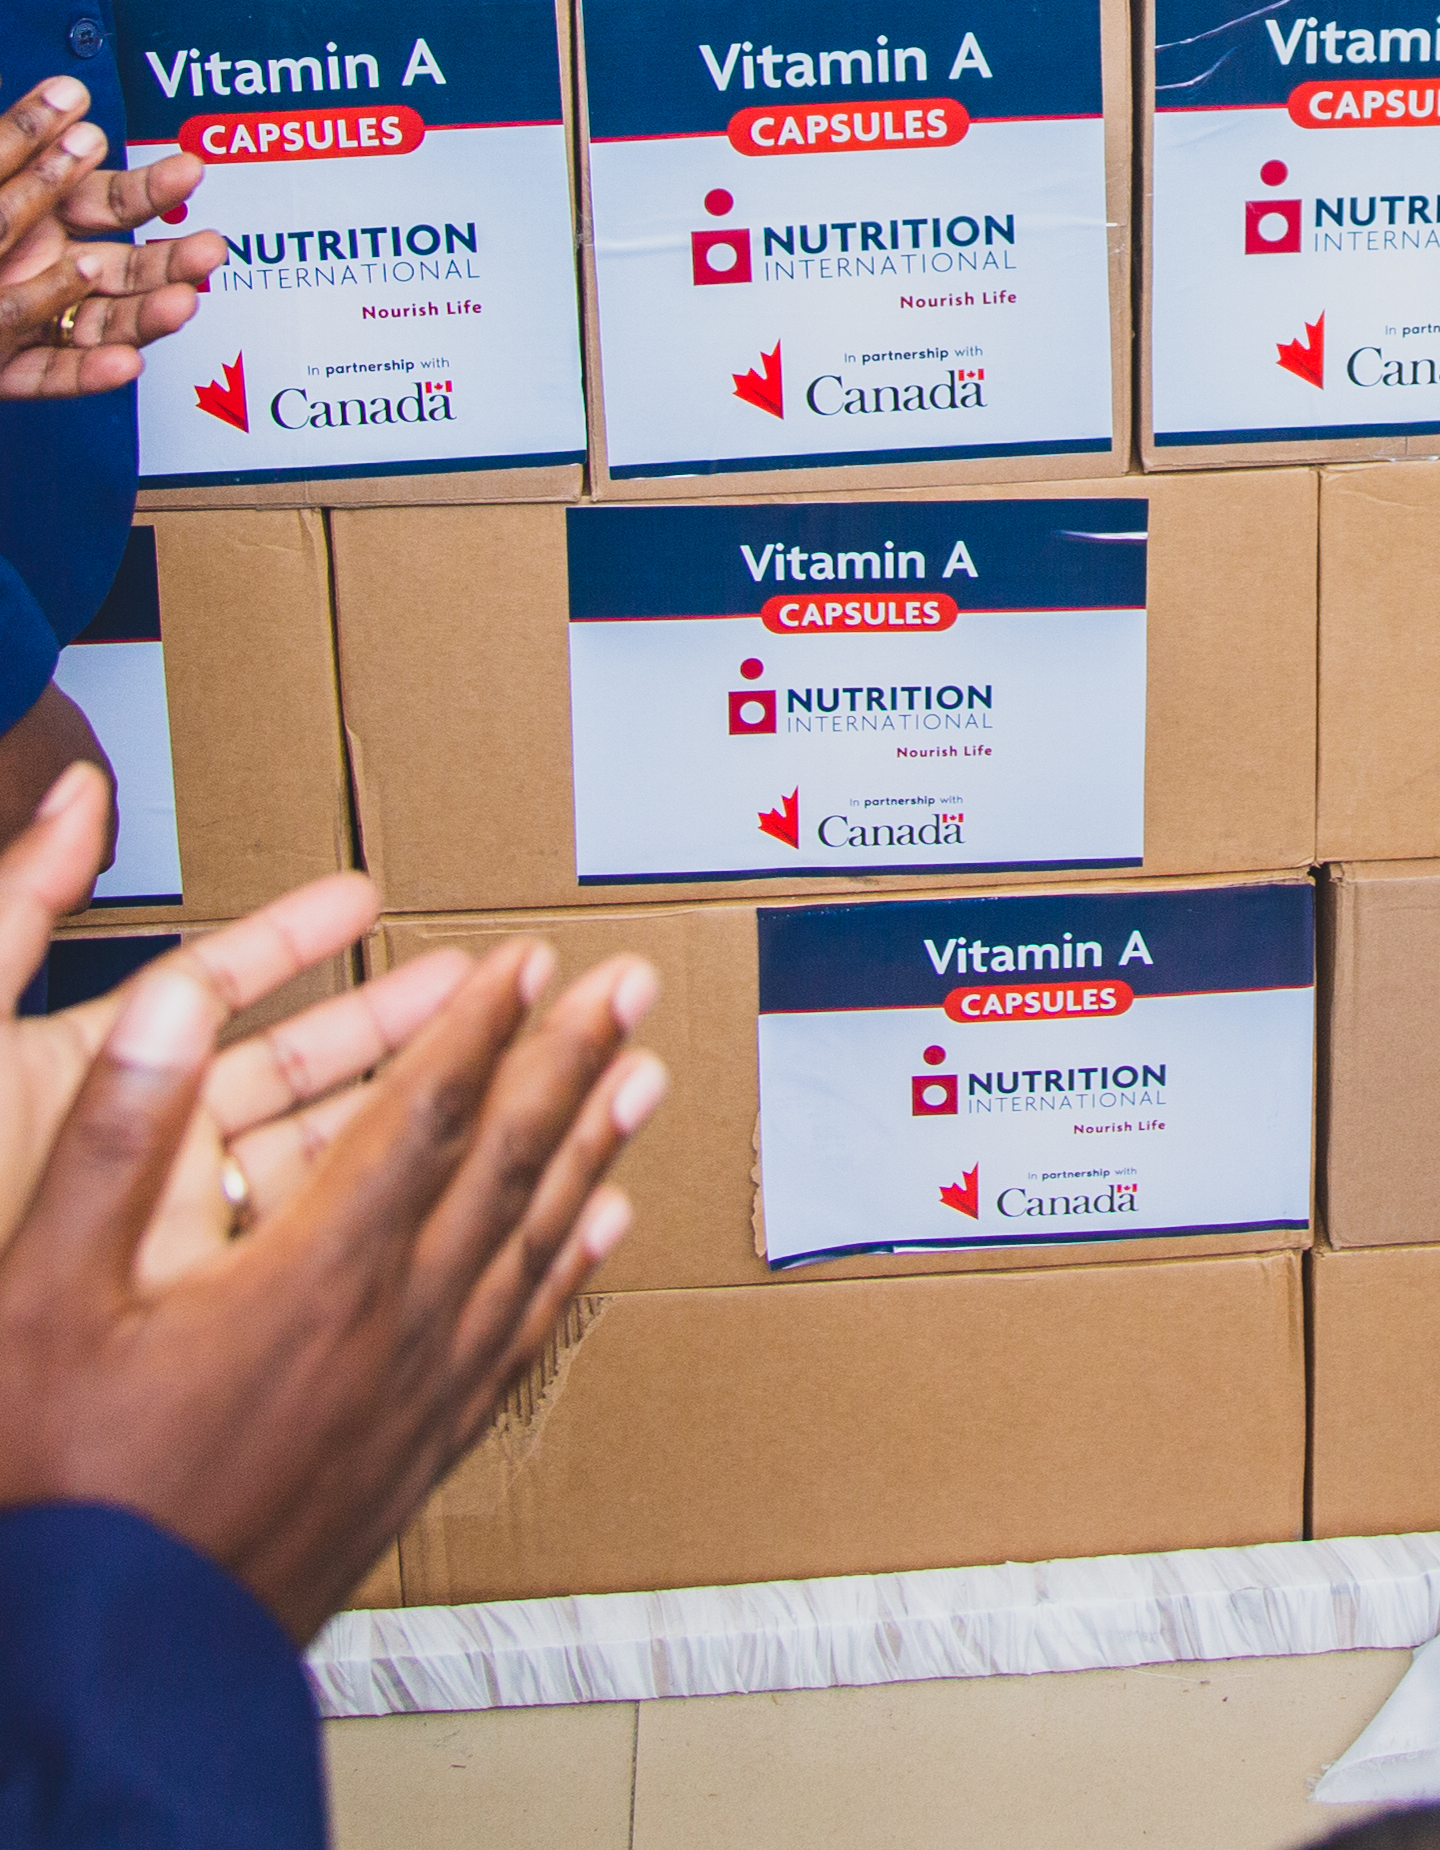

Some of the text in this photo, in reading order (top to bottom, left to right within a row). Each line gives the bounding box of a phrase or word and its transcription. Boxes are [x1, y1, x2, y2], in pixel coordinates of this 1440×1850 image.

[146, 39, 446, 97] Vitamin A
[699, 32, 992, 91] Vitamin A
[203, 116, 402, 154] CAPSULES
[751, 109, 947, 146] CAPSULES
[220, 222, 478, 267] NUTRITION
[763, 214, 1014, 256] NUTRITION
[222, 260, 480, 292] INTERNATIONAL
[765, 249, 1016, 281] INTERNATIONAL
[362, 300, 481, 319] Nourish Life
[900, 290, 1016, 308] Nourish Life
[1385, 325, 1396, 336] In
[308, 357, 450, 378] In partnership with
[844, 345, 983, 365] In partnership with
[270, 380, 456, 429] Canada
[806, 369, 988, 416] Canada
[740, 541, 978, 581] Vitamin A
[780, 602, 940, 626] CAPSULES
[787, 685, 992, 713] NUTRITION
[788, 712, 993, 734] INTERNATIONAL
[897, 745, 992, 757] Nourish Life
[849, 795, 963, 808] In partnership with
[818, 813, 966, 847] Canada
[924, 931, 1153, 974] Vitamin A
[962, 988, 1116, 1015] CAPSULES
[969, 1064, 1166, 1096] NUTRITION
[968, 1091, 1167, 1114] INTERNATIONAL
[1074, 1120, 1165, 1134] Nourish Life
[1028, 1167, 1138, 1181] In partnership with
[997, 1183, 1139, 1217] Canada
